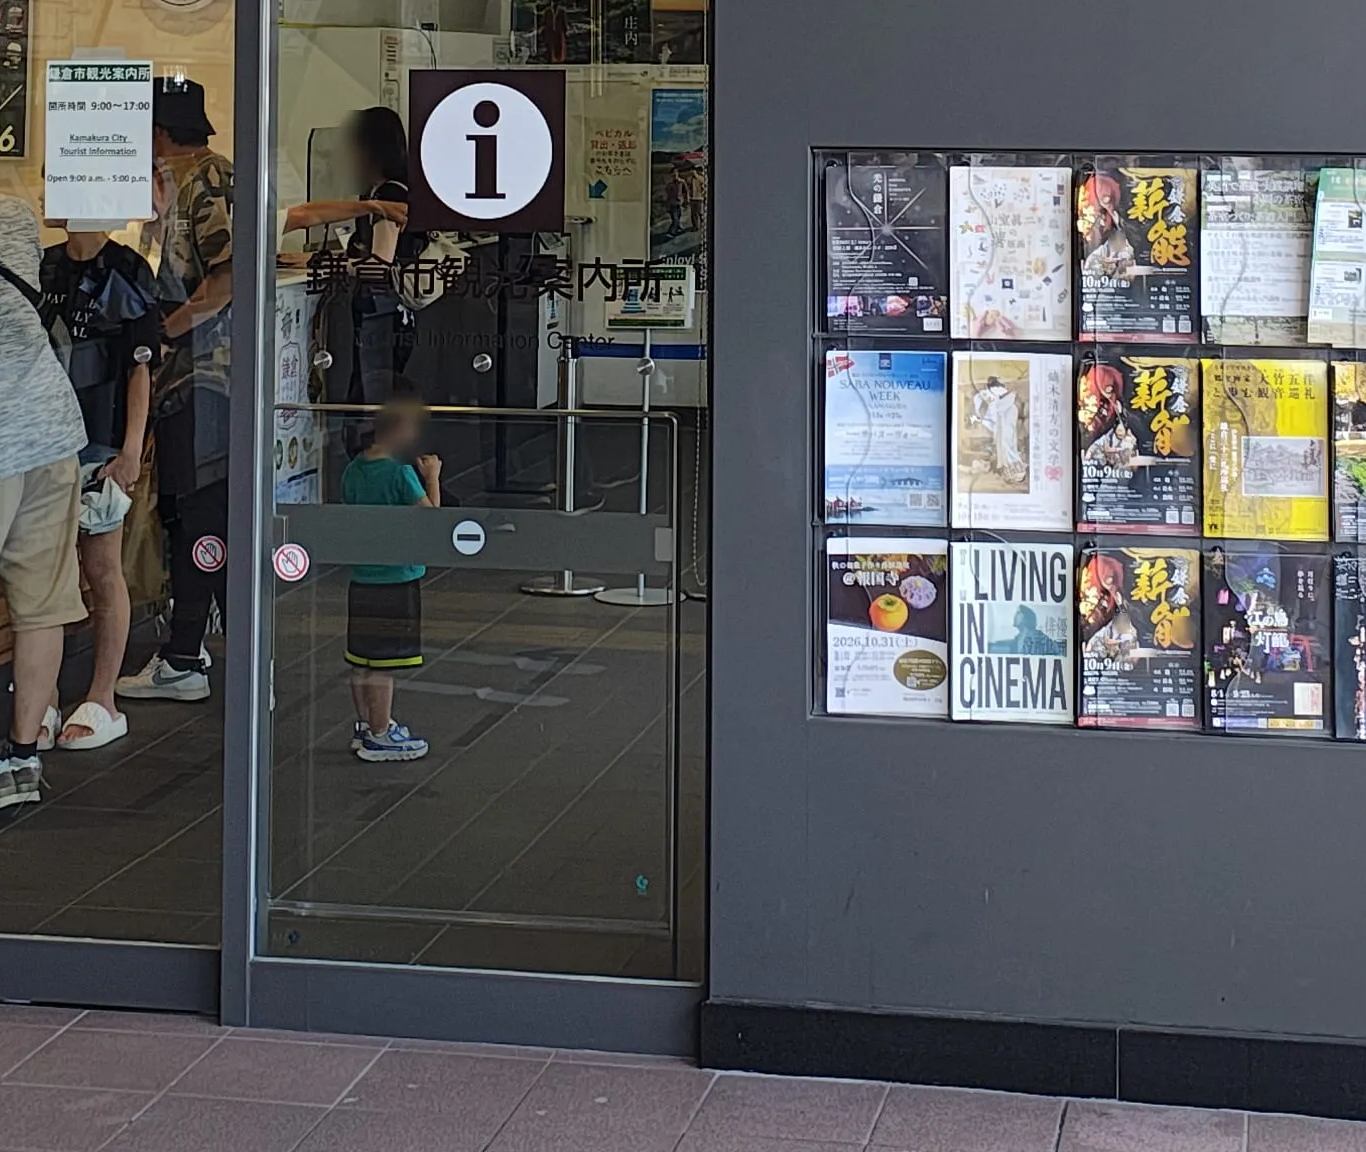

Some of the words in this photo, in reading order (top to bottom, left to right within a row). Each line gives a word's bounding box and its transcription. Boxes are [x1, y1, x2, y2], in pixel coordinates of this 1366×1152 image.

[49, 67, 150, 80] 鎌倉市観光案内所
[69, 134, 109, 142] Kamakura
[112, 134, 128, 143] City
[60, 147, 87, 155] Tourist
[89, 147, 137, 155] Information
[47, 174, 68, 183] Open
[69, 174, 86, 182] 9:00
[112, 174, 129, 182] 5:00
[131, 175, 149, 184] p.m.
[306, 252, 662, 303] 鎌倉市観光案内所
[428, 330, 539, 348] Information
[547, 330, 615, 349] Center
[874, 379, 931, 391] NOUVEAU
[868, 391, 901, 401] WEEK
[973, 549, 1067, 602] LIVING
[1244, 609, 1289, 627] 江の島
[959, 603, 984, 654] IN
[959, 656, 1067, 711] CINEMA
